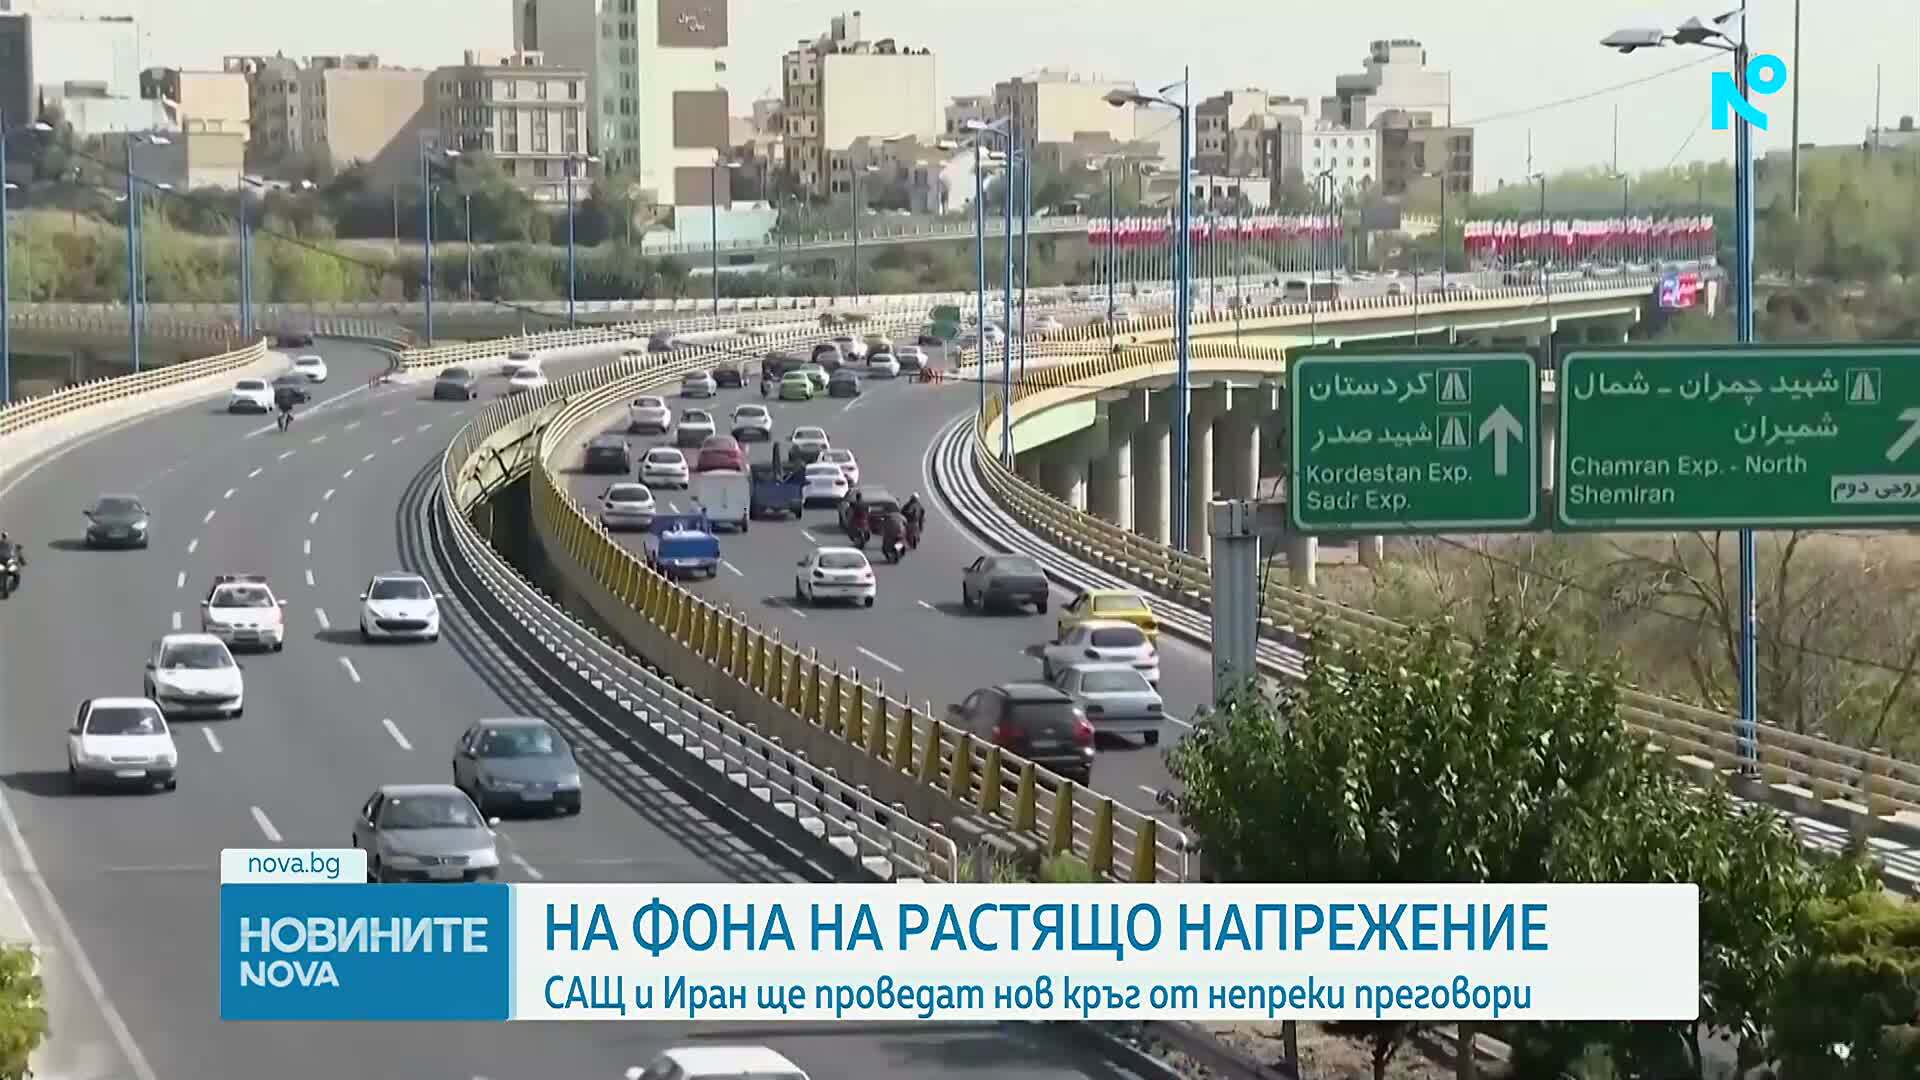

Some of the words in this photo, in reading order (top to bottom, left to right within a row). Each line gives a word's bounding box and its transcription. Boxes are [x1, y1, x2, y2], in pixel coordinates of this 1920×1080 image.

[1309, 372, 1433, 402] کردستان
[1574, 370, 1650, 399] شمال
[1679, 372, 1763, 405] چمران
[1771, 368, 1840, 401] شهید
[1311, 424, 1373, 451] صدر
[1378, 421, 1433, 448] شهید
[1735, 413, 1839, 445] شمیران
[1306, 463, 1422, 484] Kordestan
[1429, 463, 1472, 484] Exp.
[1570, 455, 1670, 476] Chamran
[1678, 456, 1723, 477] Exp.
[1745, 455, 1807, 474] North
[1307, 490, 1359, 510] Sadr
[1366, 490, 1412, 512] Exp.
[1833, 481, 1869, 501] دوم
